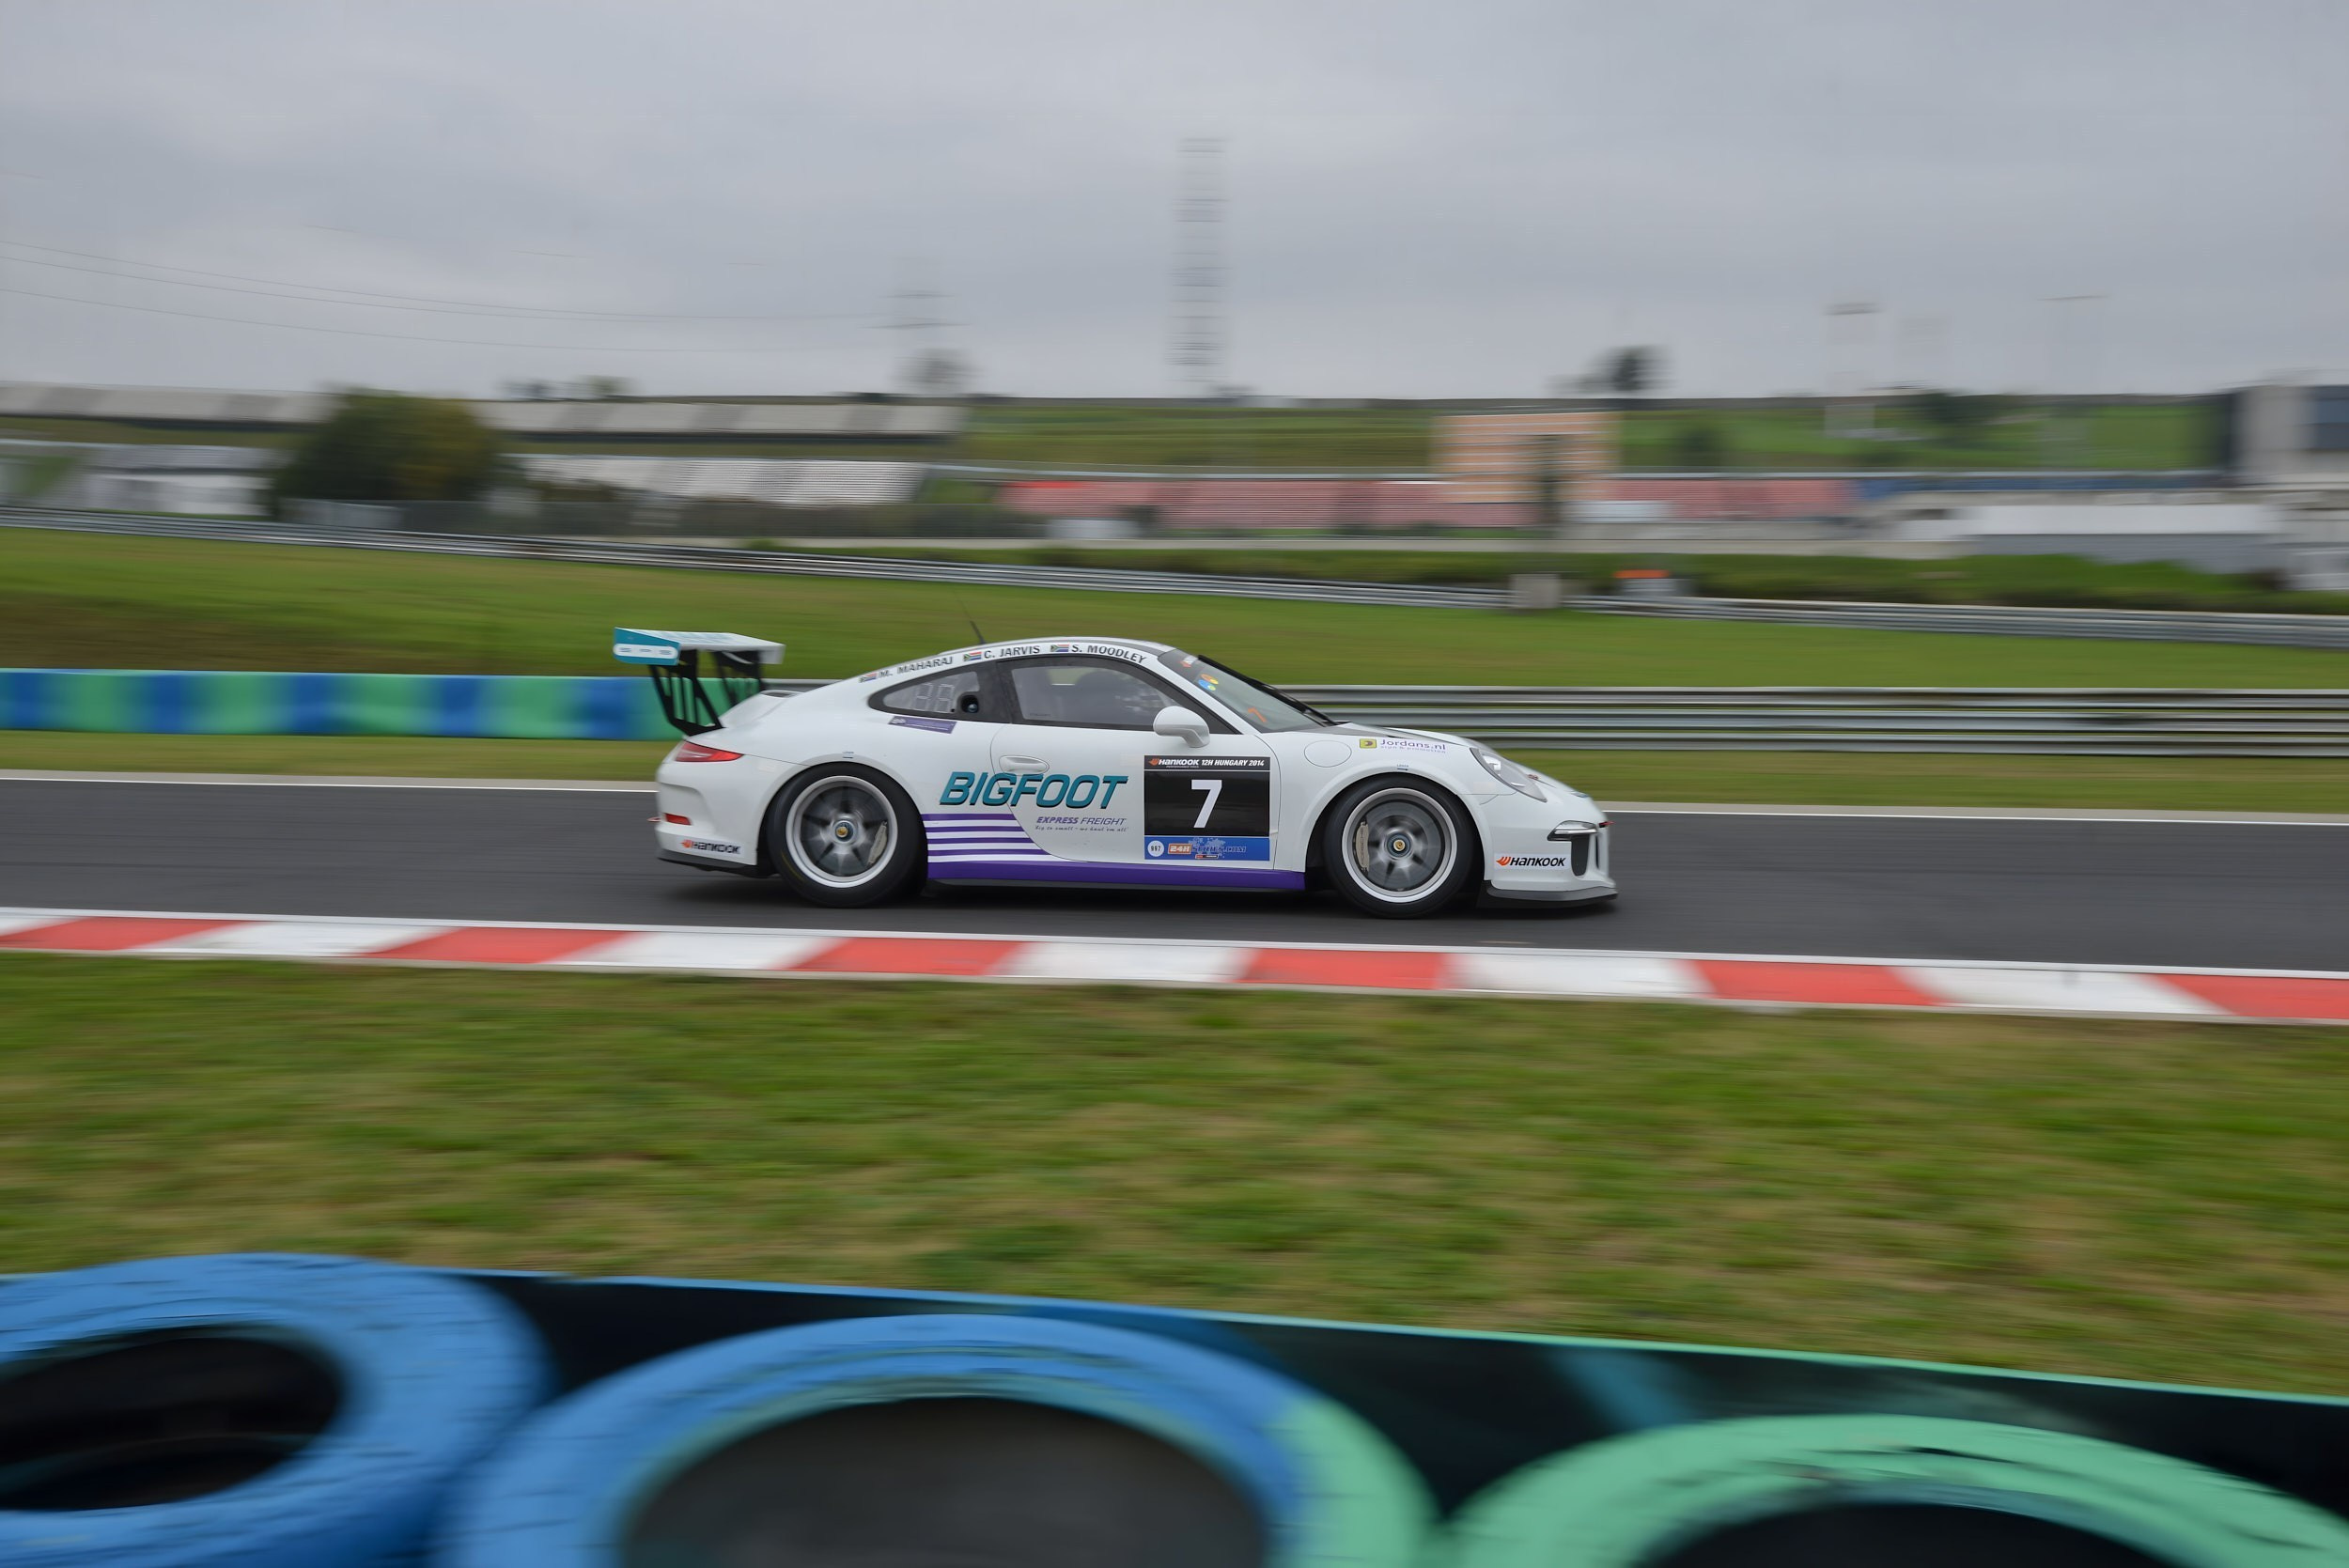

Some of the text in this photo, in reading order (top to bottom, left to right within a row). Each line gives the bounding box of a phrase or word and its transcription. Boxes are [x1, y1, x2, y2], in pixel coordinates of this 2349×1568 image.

[984, 644, 1040, 659] C. JARVIS
[1087, 644, 1147, 663] MOODLEY
[896, 657, 954, 673] MAHARAJ
[1380, 738, 1446, 750] Jordans.nl
[940, 771, 1128, 810] BIGFOOT
[1191, 779, 1222, 829] 7
[1081, 817, 1128, 826] FREIGHT
